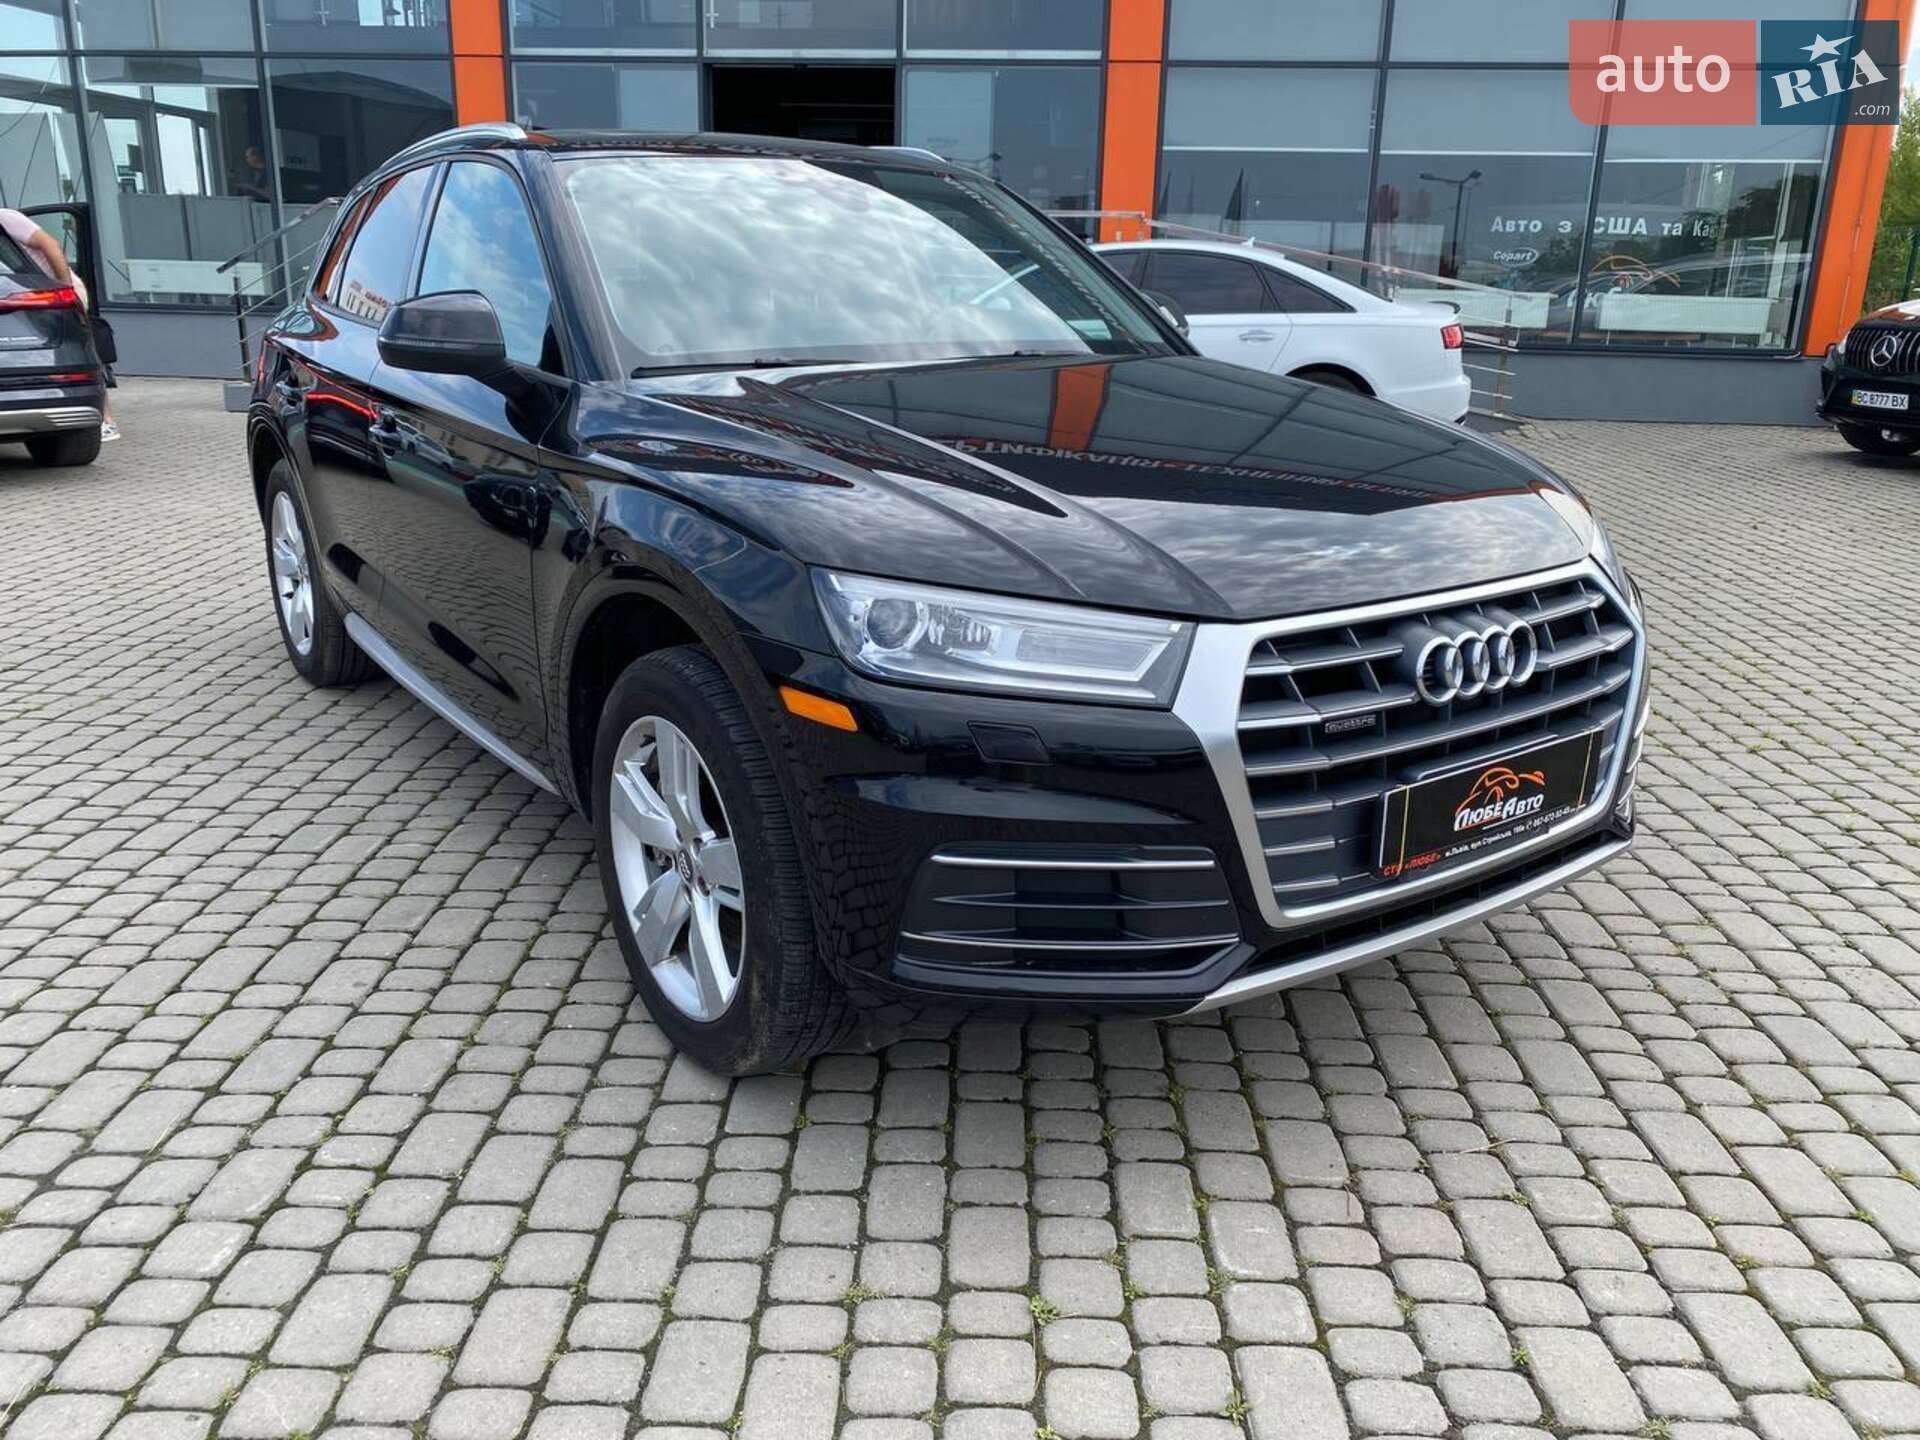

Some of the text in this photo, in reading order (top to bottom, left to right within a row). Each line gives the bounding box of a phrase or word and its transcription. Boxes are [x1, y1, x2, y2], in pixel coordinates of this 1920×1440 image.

[1490, 216, 1543, 233] Авто
[1593, 217, 1648, 235] США
[1661, 222, 1683, 236] та
